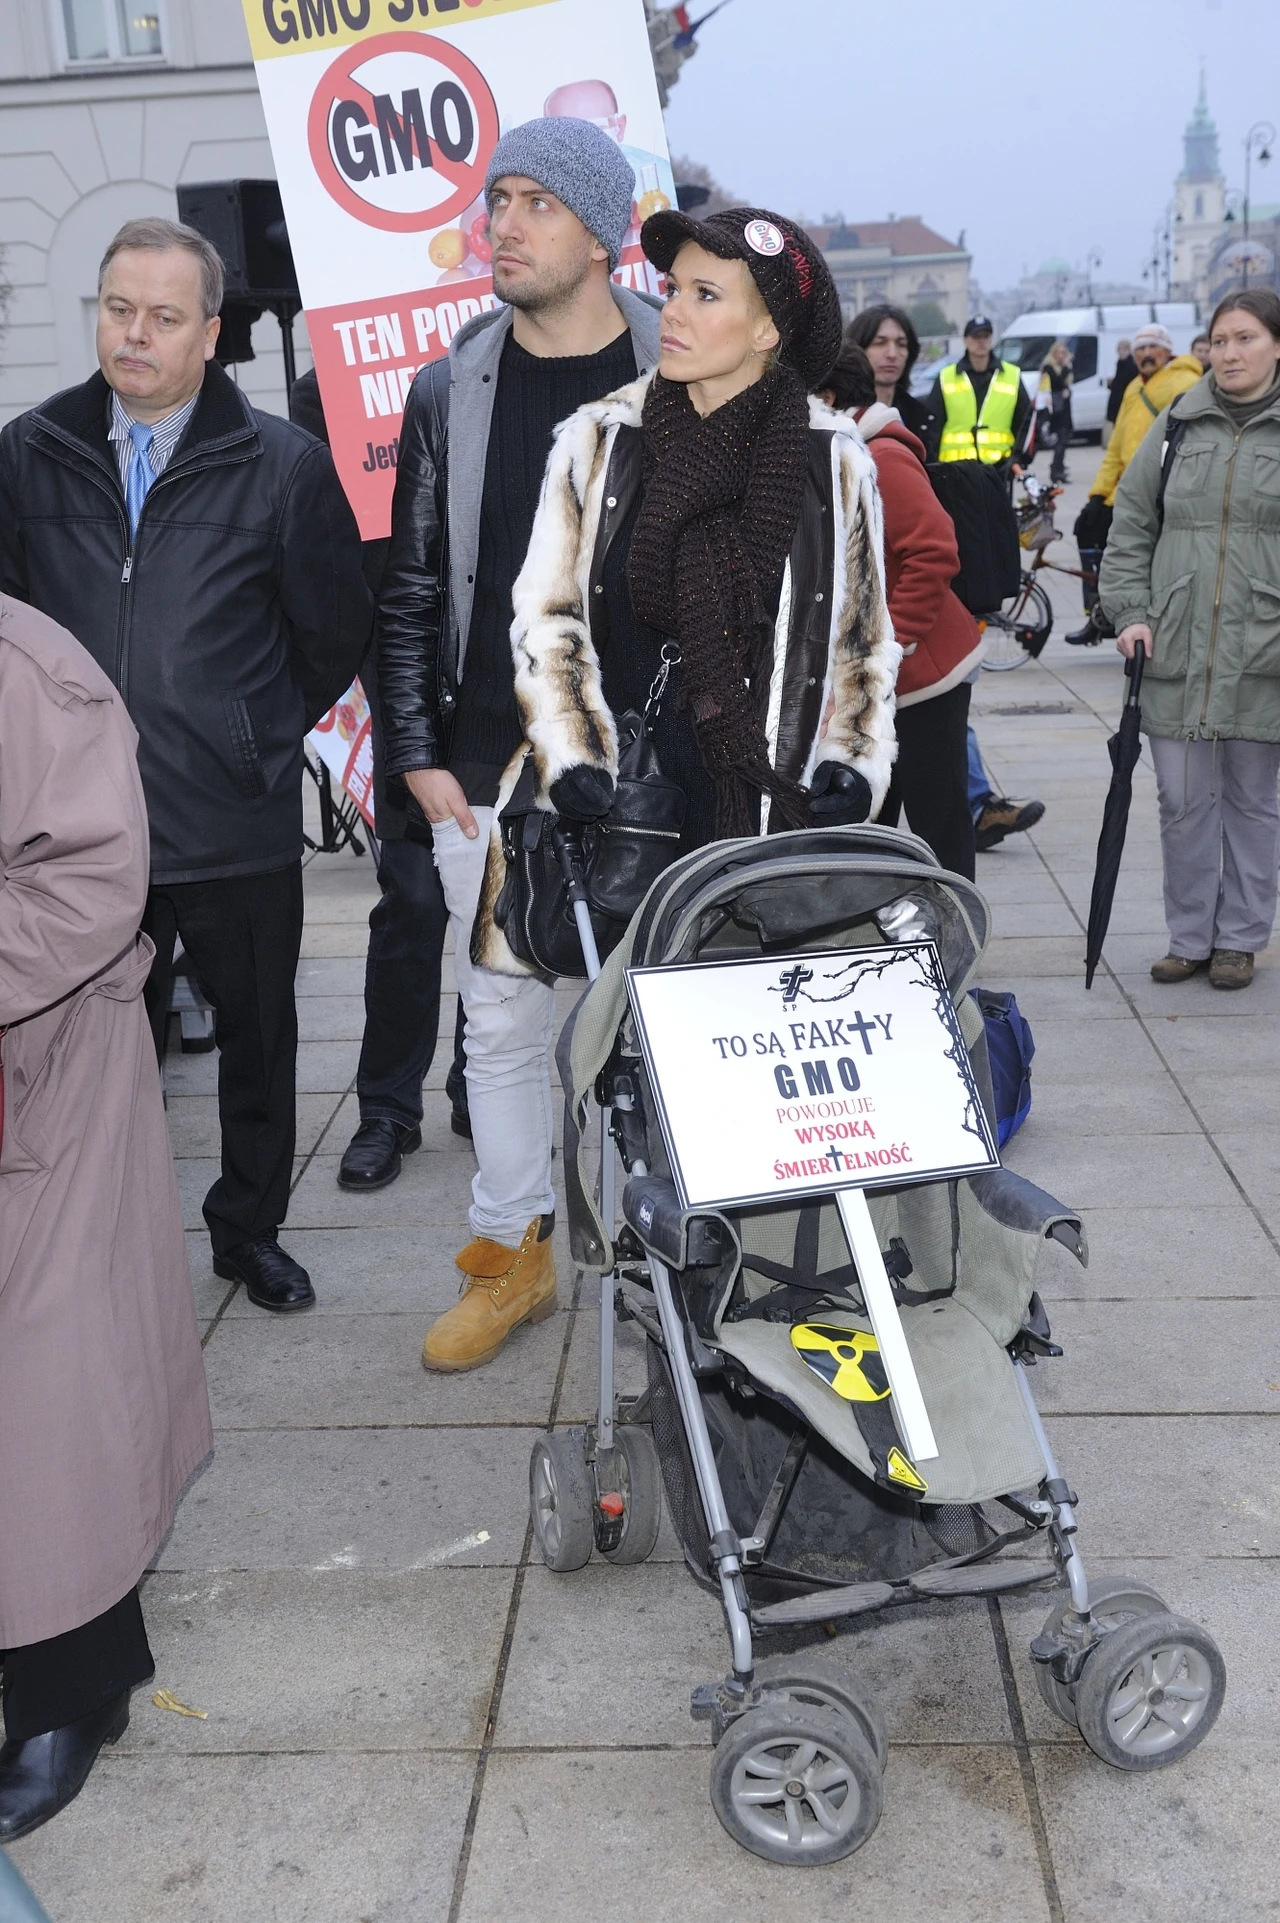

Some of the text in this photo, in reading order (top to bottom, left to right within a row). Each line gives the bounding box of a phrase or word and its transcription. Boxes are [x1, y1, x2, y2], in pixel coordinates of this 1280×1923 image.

[263, 0, 371, 45] GMO
[333, 81, 474, 182] GMO
[333, 313, 406, 366] TEN
[712, 1035, 748, 1059] TO
[752, 1031, 787, 1058] SĄ
[773, 1057, 861, 1100] GMO
[775, 1096, 876, 1124] POWODUJE
[794, 1119, 876, 1145] WYSOKĄ
